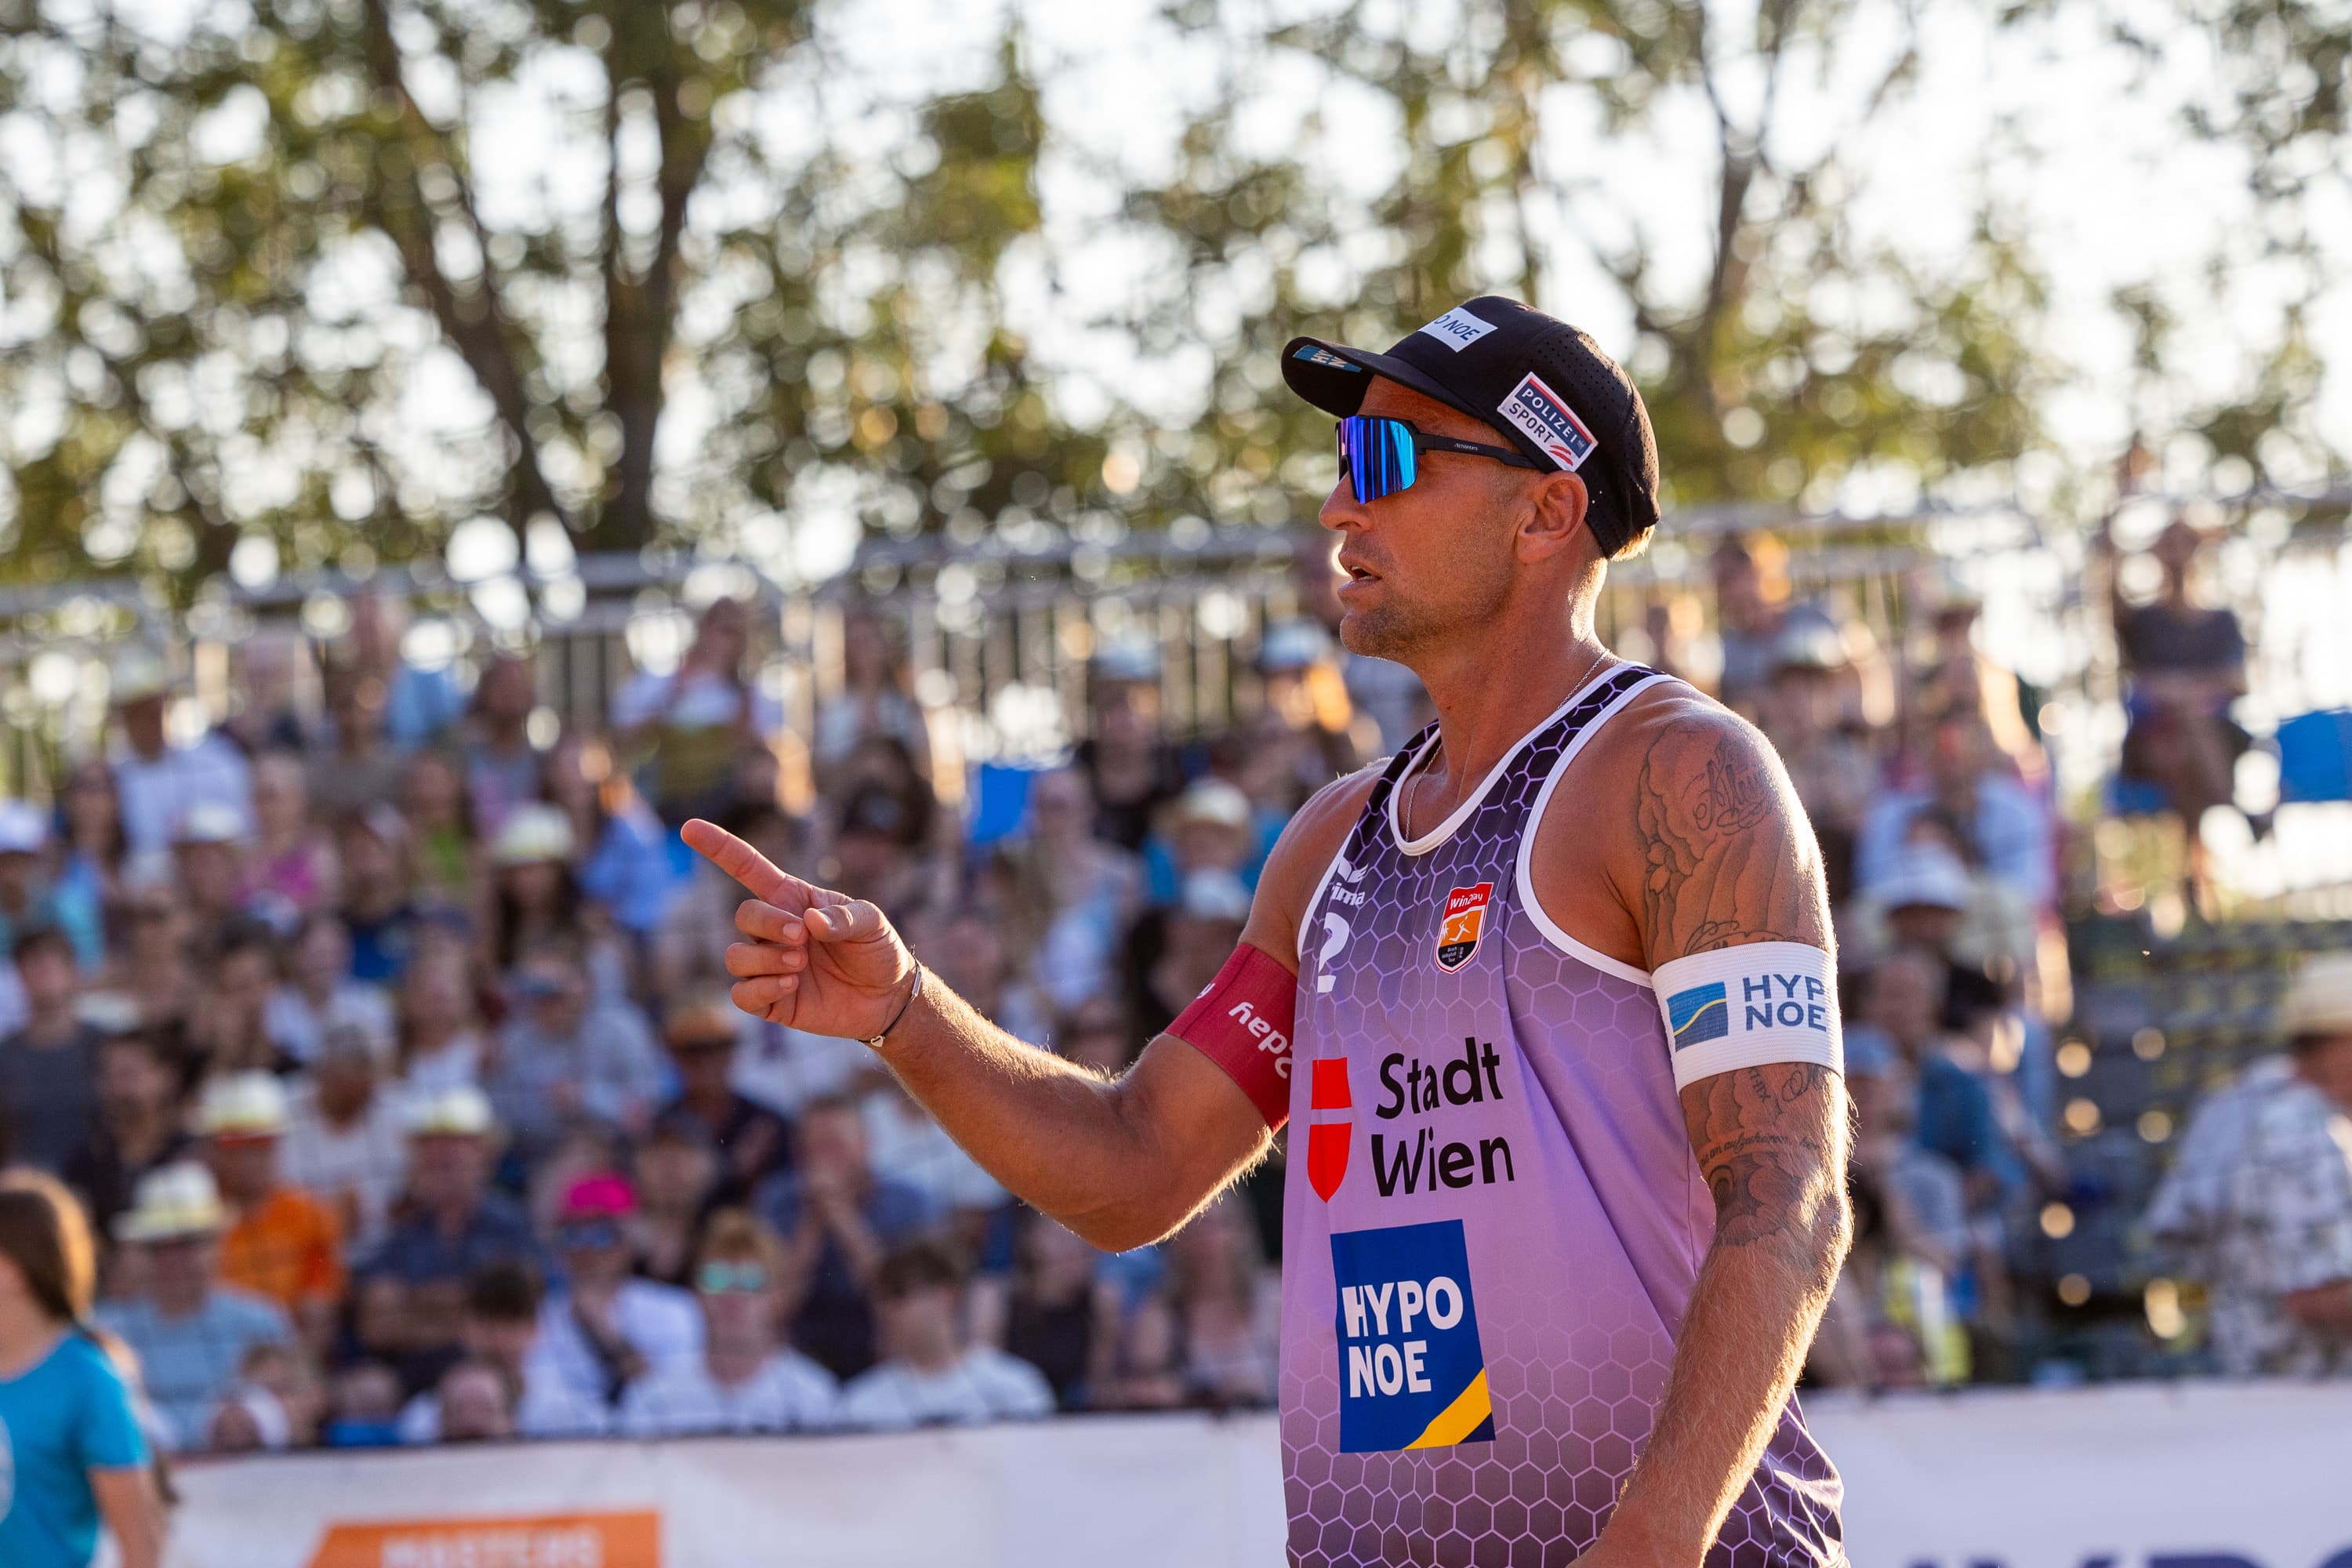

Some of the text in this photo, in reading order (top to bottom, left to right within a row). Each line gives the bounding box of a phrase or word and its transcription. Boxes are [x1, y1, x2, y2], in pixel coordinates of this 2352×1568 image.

[1443, 320, 1480, 340] NOE
[1508, 402, 1555, 443] SPORT
[1521, 388, 1577, 443] POLIZEI
[1742, 974, 1825, 1002] HYP
[1745, 1001, 1827, 1032] NOE
[1375, 1036, 1504, 1120] Stadt
[1371, 1126, 1515, 1197] Wien
[1341, 1276, 1464, 1338] HYPO
[1348, 1340, 1432, 1398] NOE
